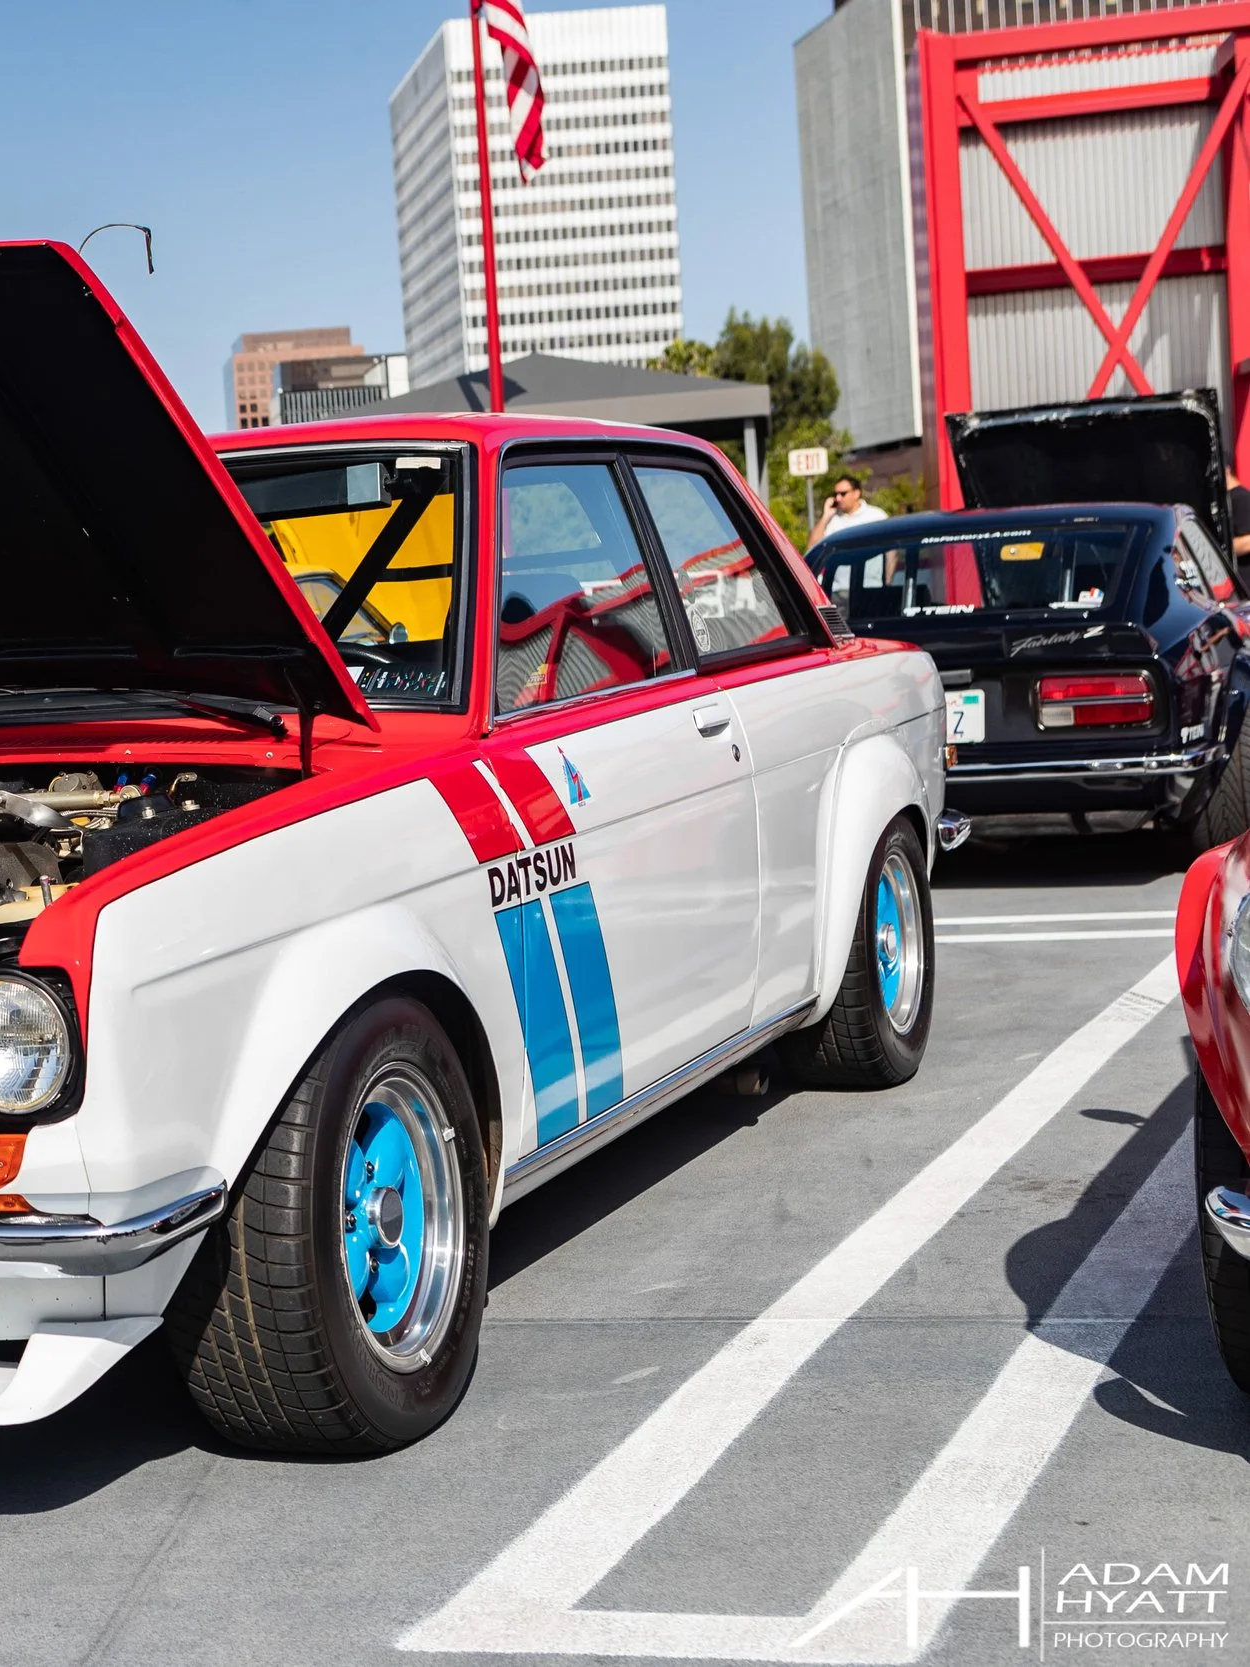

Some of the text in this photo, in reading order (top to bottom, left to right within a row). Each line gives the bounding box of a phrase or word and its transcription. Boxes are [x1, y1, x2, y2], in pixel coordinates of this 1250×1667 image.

[796, 452, 821, 471] EXIT
[922, 604, 974, 615] TEIN
[487, 842, 576, 907] DATSUN
